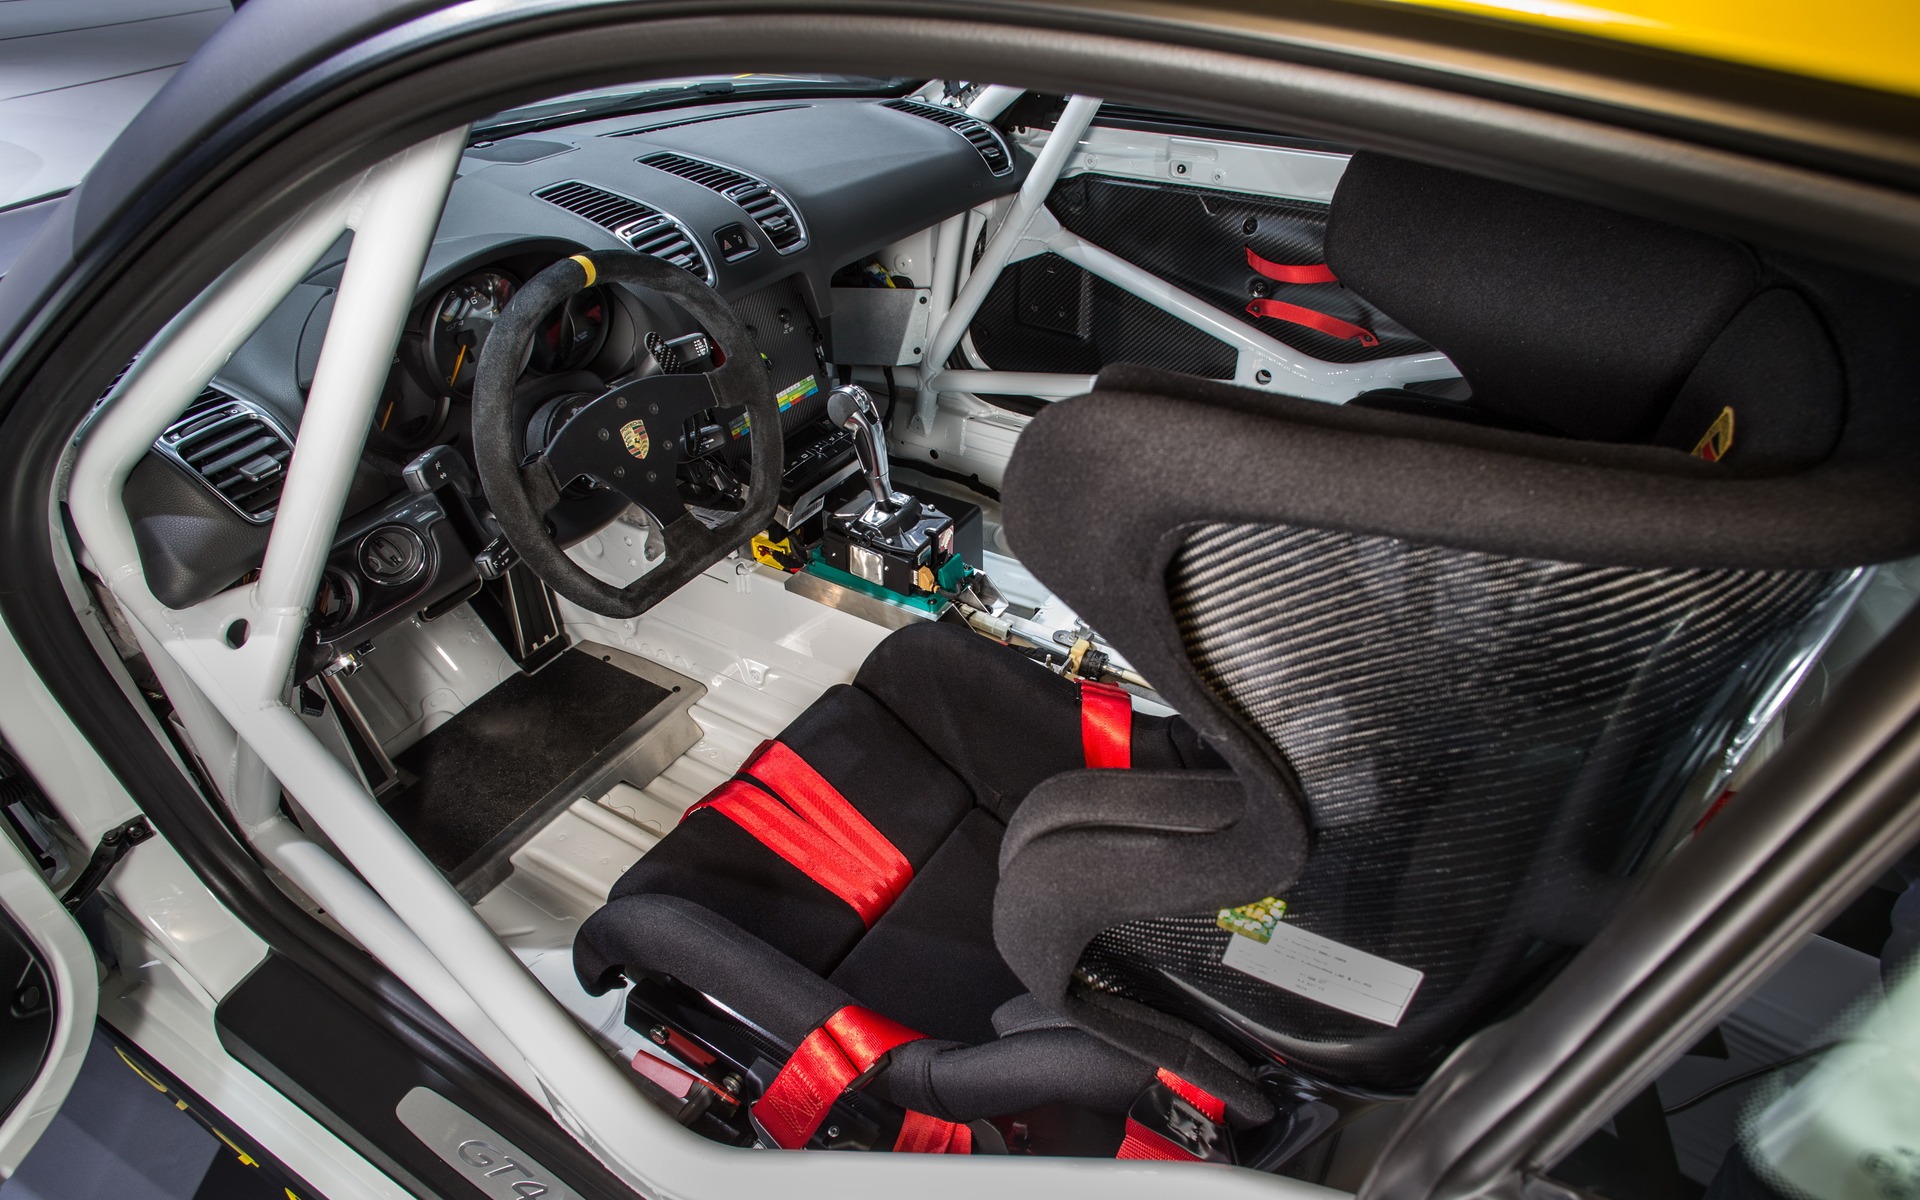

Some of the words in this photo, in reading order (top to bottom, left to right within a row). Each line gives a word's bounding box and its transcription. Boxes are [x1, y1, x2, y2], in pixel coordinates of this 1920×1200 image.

[469, 296, 478, 305] 6
[486, 310, 493, 319] 7
[445, 319, 465, 332] GT4
[458, 1139, 549, 1200] GT4
